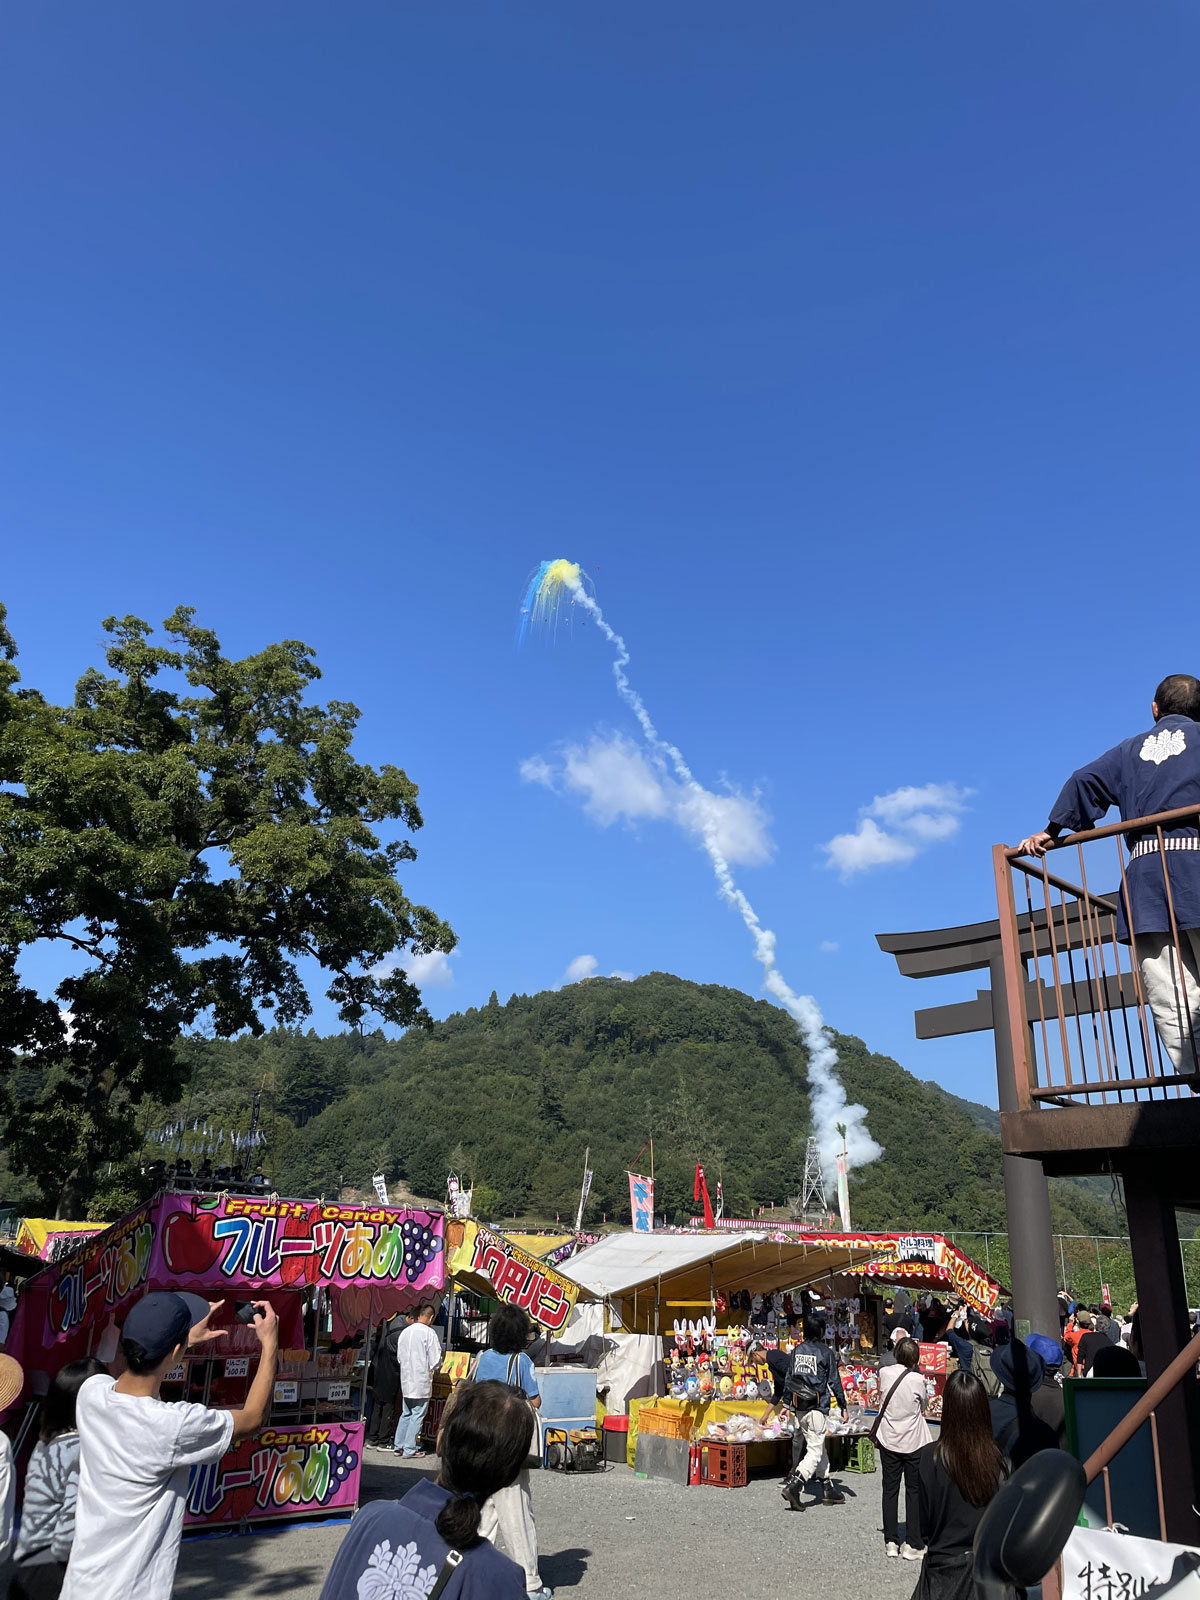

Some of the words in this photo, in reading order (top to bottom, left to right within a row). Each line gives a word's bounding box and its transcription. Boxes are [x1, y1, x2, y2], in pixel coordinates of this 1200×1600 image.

[61, 1242, 100, 1274] Fruit
[106, 1210, 147, 1245] Candy
[225, 1200, 307, 1218] Fruit
[321, 1206, 401, 1224] Candy
[58, 1222, 153, 1332] フルーツあめ
[213, 1216, 404, 1280] フルーツあめ
[260, 1427, 331, 1445] Candy
